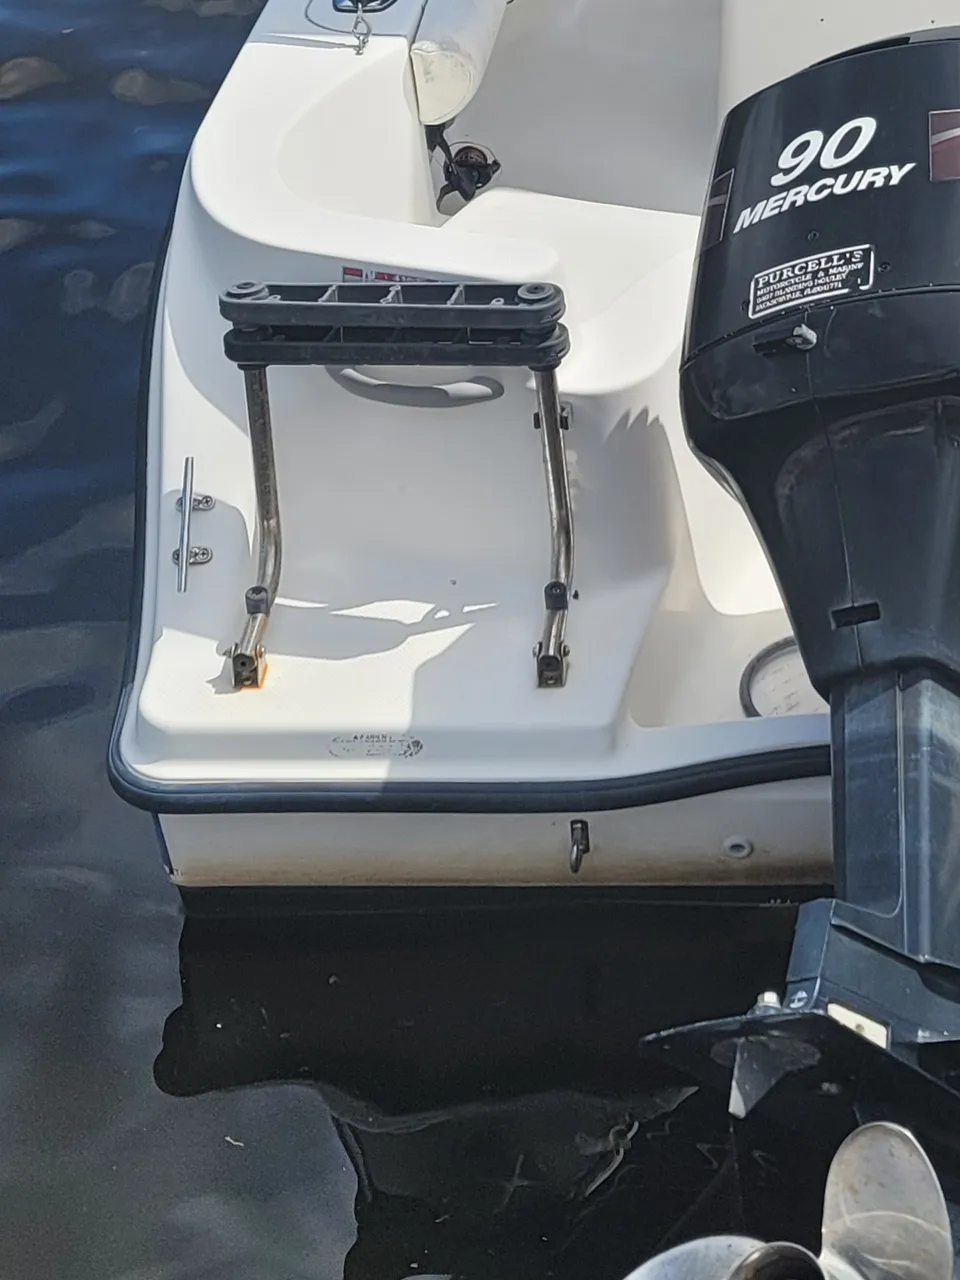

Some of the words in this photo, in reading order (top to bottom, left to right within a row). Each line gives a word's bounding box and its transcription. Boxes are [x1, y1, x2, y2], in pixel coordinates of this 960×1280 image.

[770, 116, 877, 187] 90
[732, 162, 917, 234] MERCURY
[756, 273, 812, 296] MOTORCYCLE
[757, 250, 863, 288] PURCELL'S
